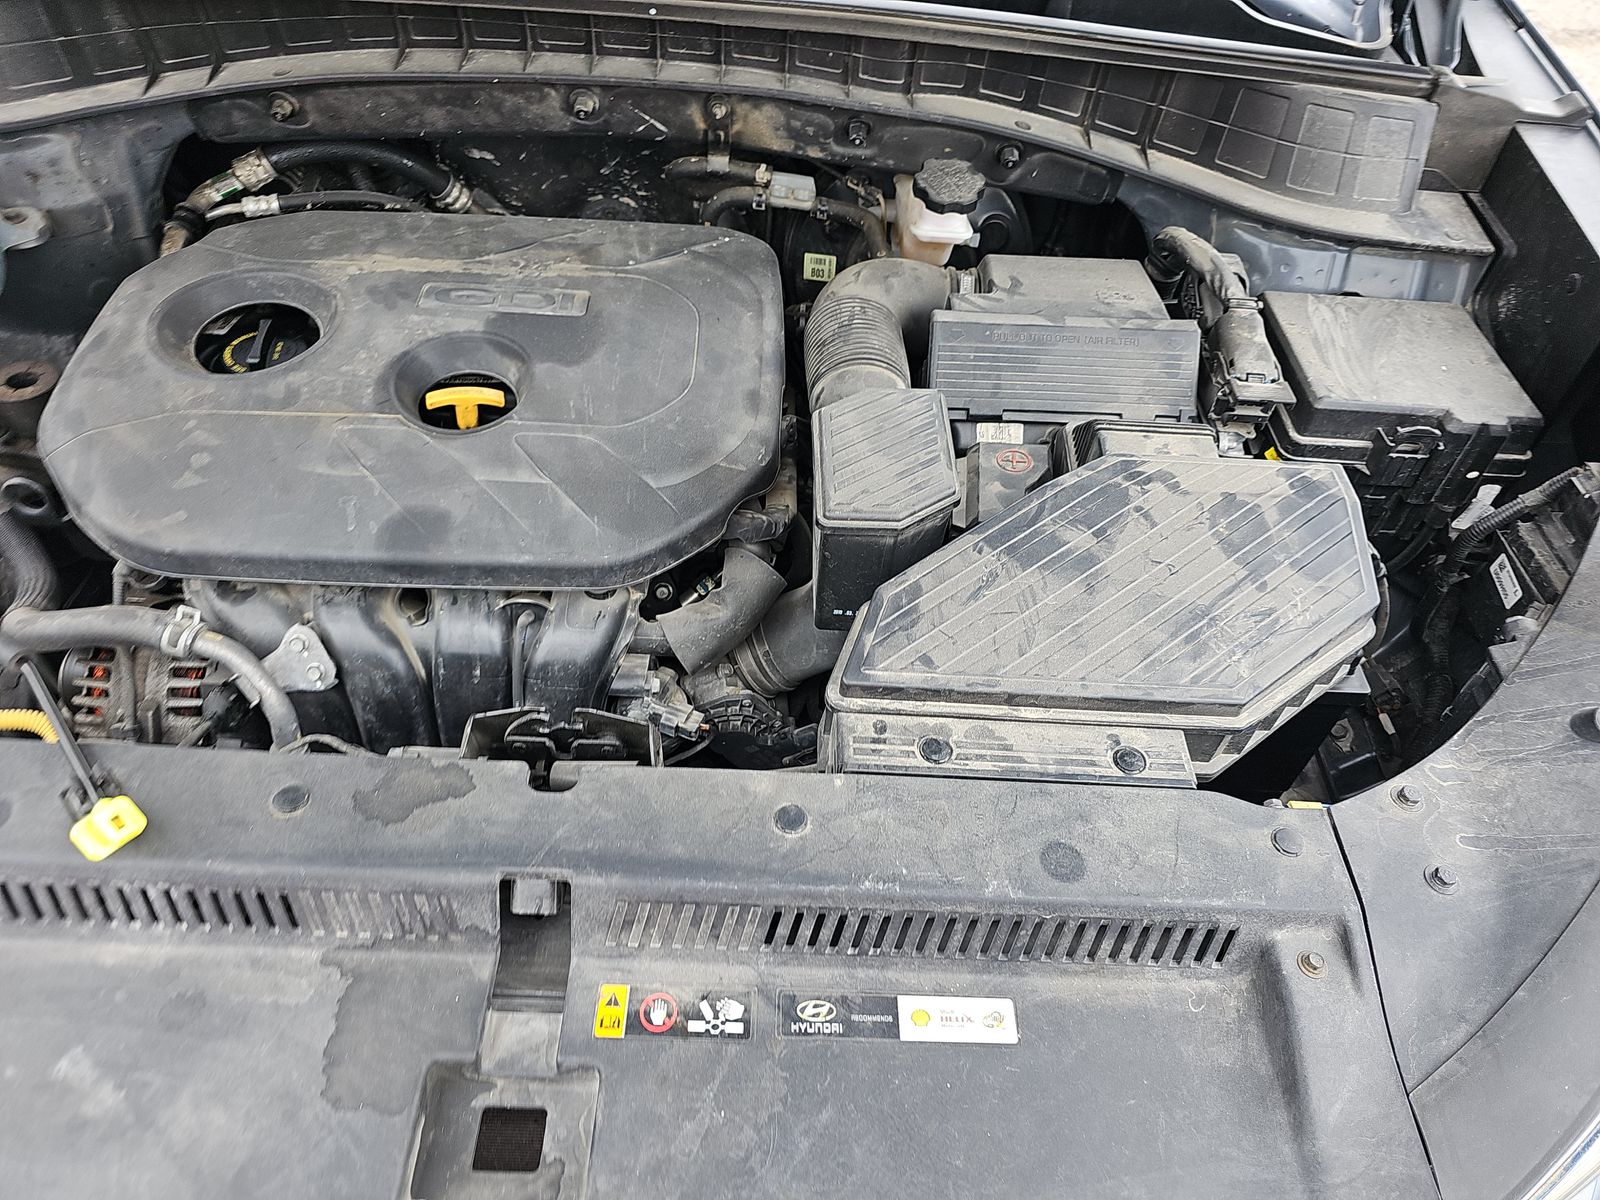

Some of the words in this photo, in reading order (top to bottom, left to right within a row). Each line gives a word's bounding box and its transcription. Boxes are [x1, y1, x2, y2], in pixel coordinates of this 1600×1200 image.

[434, 287, 577, 313] GDI
[1041, 332, 1054, 343] TO
[1055, 333, 1081, 344] OPEN
[850, 1013, 894, 1023] RECOMMENDS
[790, 1021, 843, 1034] HYUNDAI
